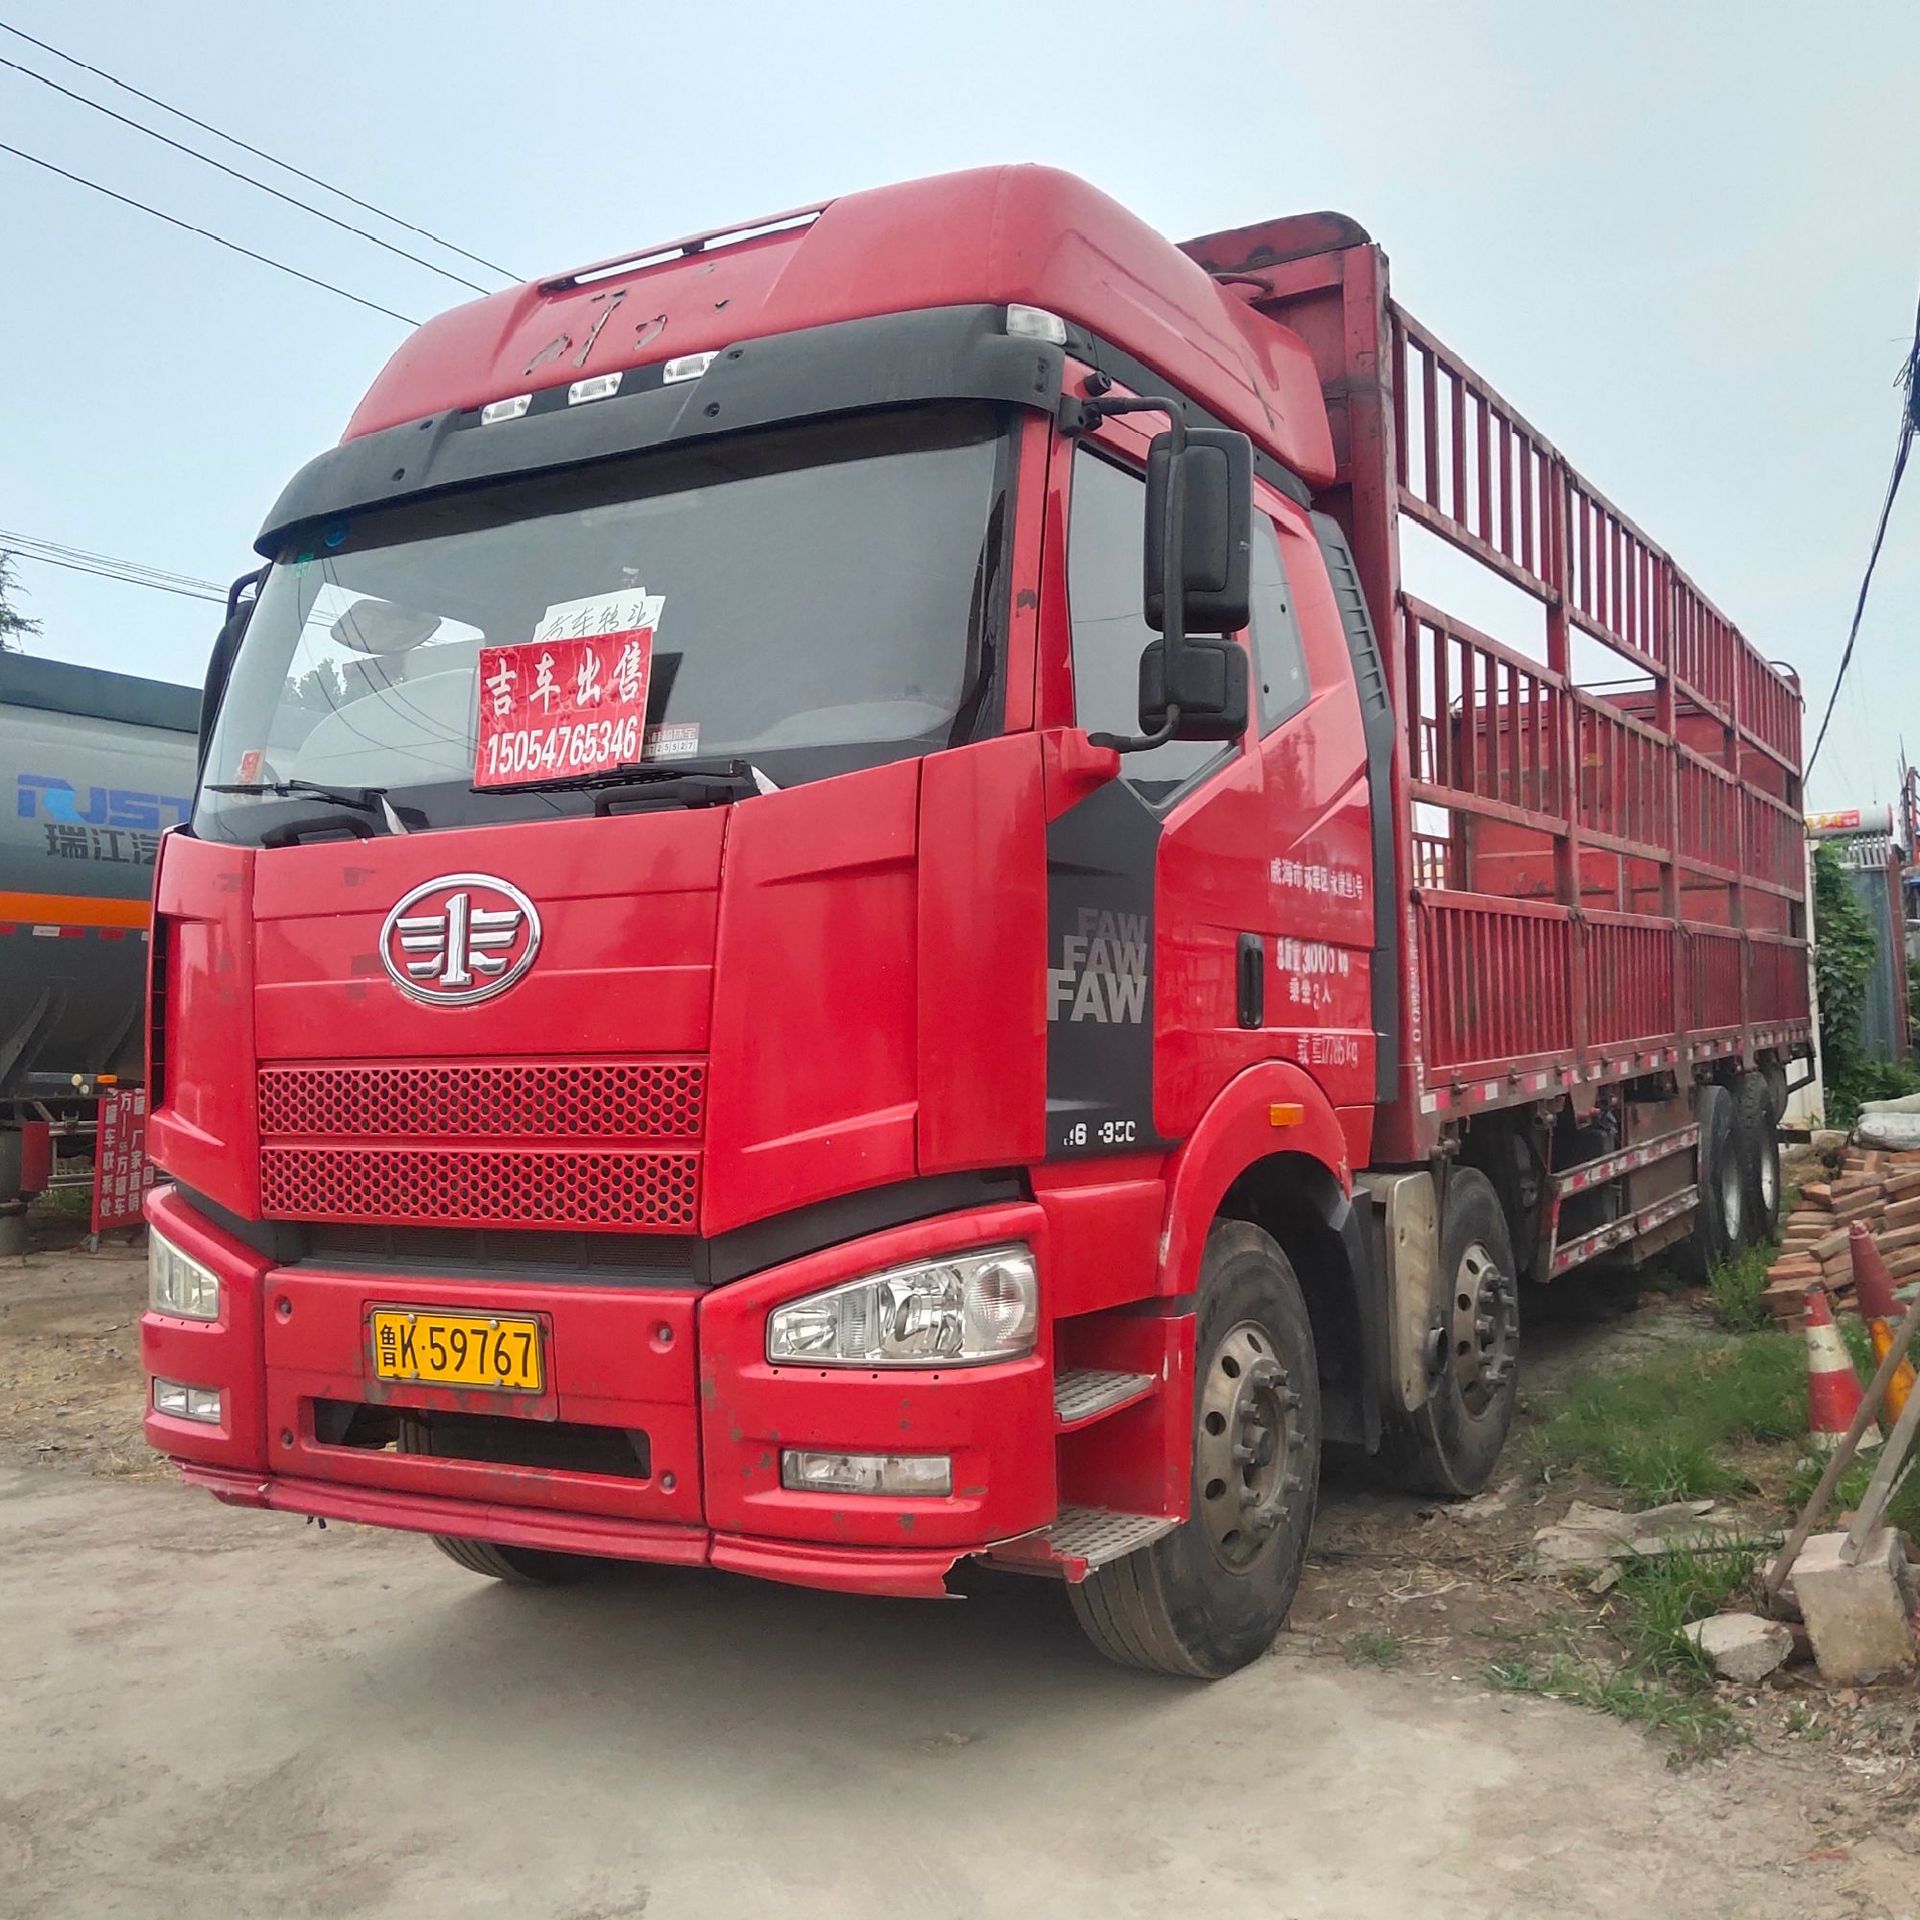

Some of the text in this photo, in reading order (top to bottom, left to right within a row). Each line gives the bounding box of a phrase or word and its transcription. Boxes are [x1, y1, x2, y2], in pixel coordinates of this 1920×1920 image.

[486, 641, 643, 717] 吉车出售
[487, 715, 639, 776] 15054765346
[1077, 907, 1148, 944] FAW
[1063, 935, 1147, 983] FAW
[1046, 967, 1148, 1024] FAW
